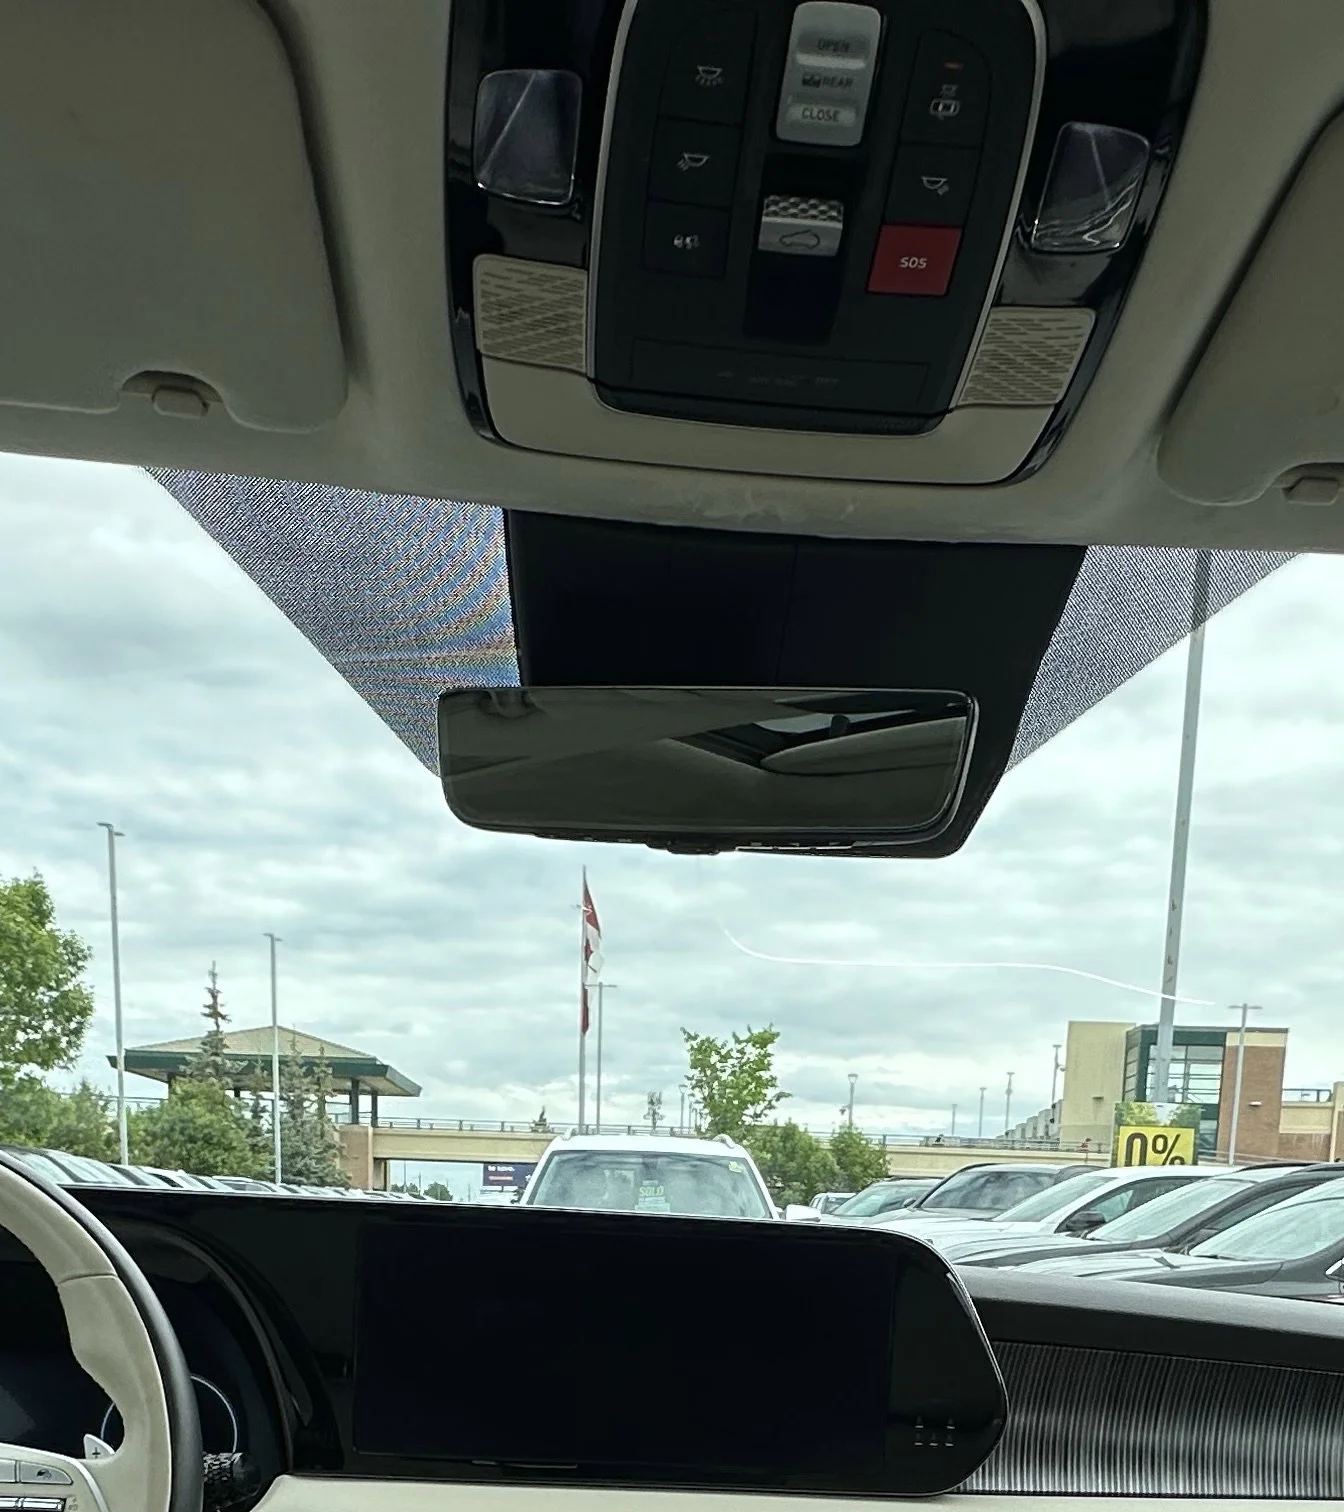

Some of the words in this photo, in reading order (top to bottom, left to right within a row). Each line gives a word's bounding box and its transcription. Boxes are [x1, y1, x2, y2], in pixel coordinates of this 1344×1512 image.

[817, 38, 850, 52] OPEN
[801, 108, 840, 121] CLOSE
[898, 256, 927, 269] SOS
